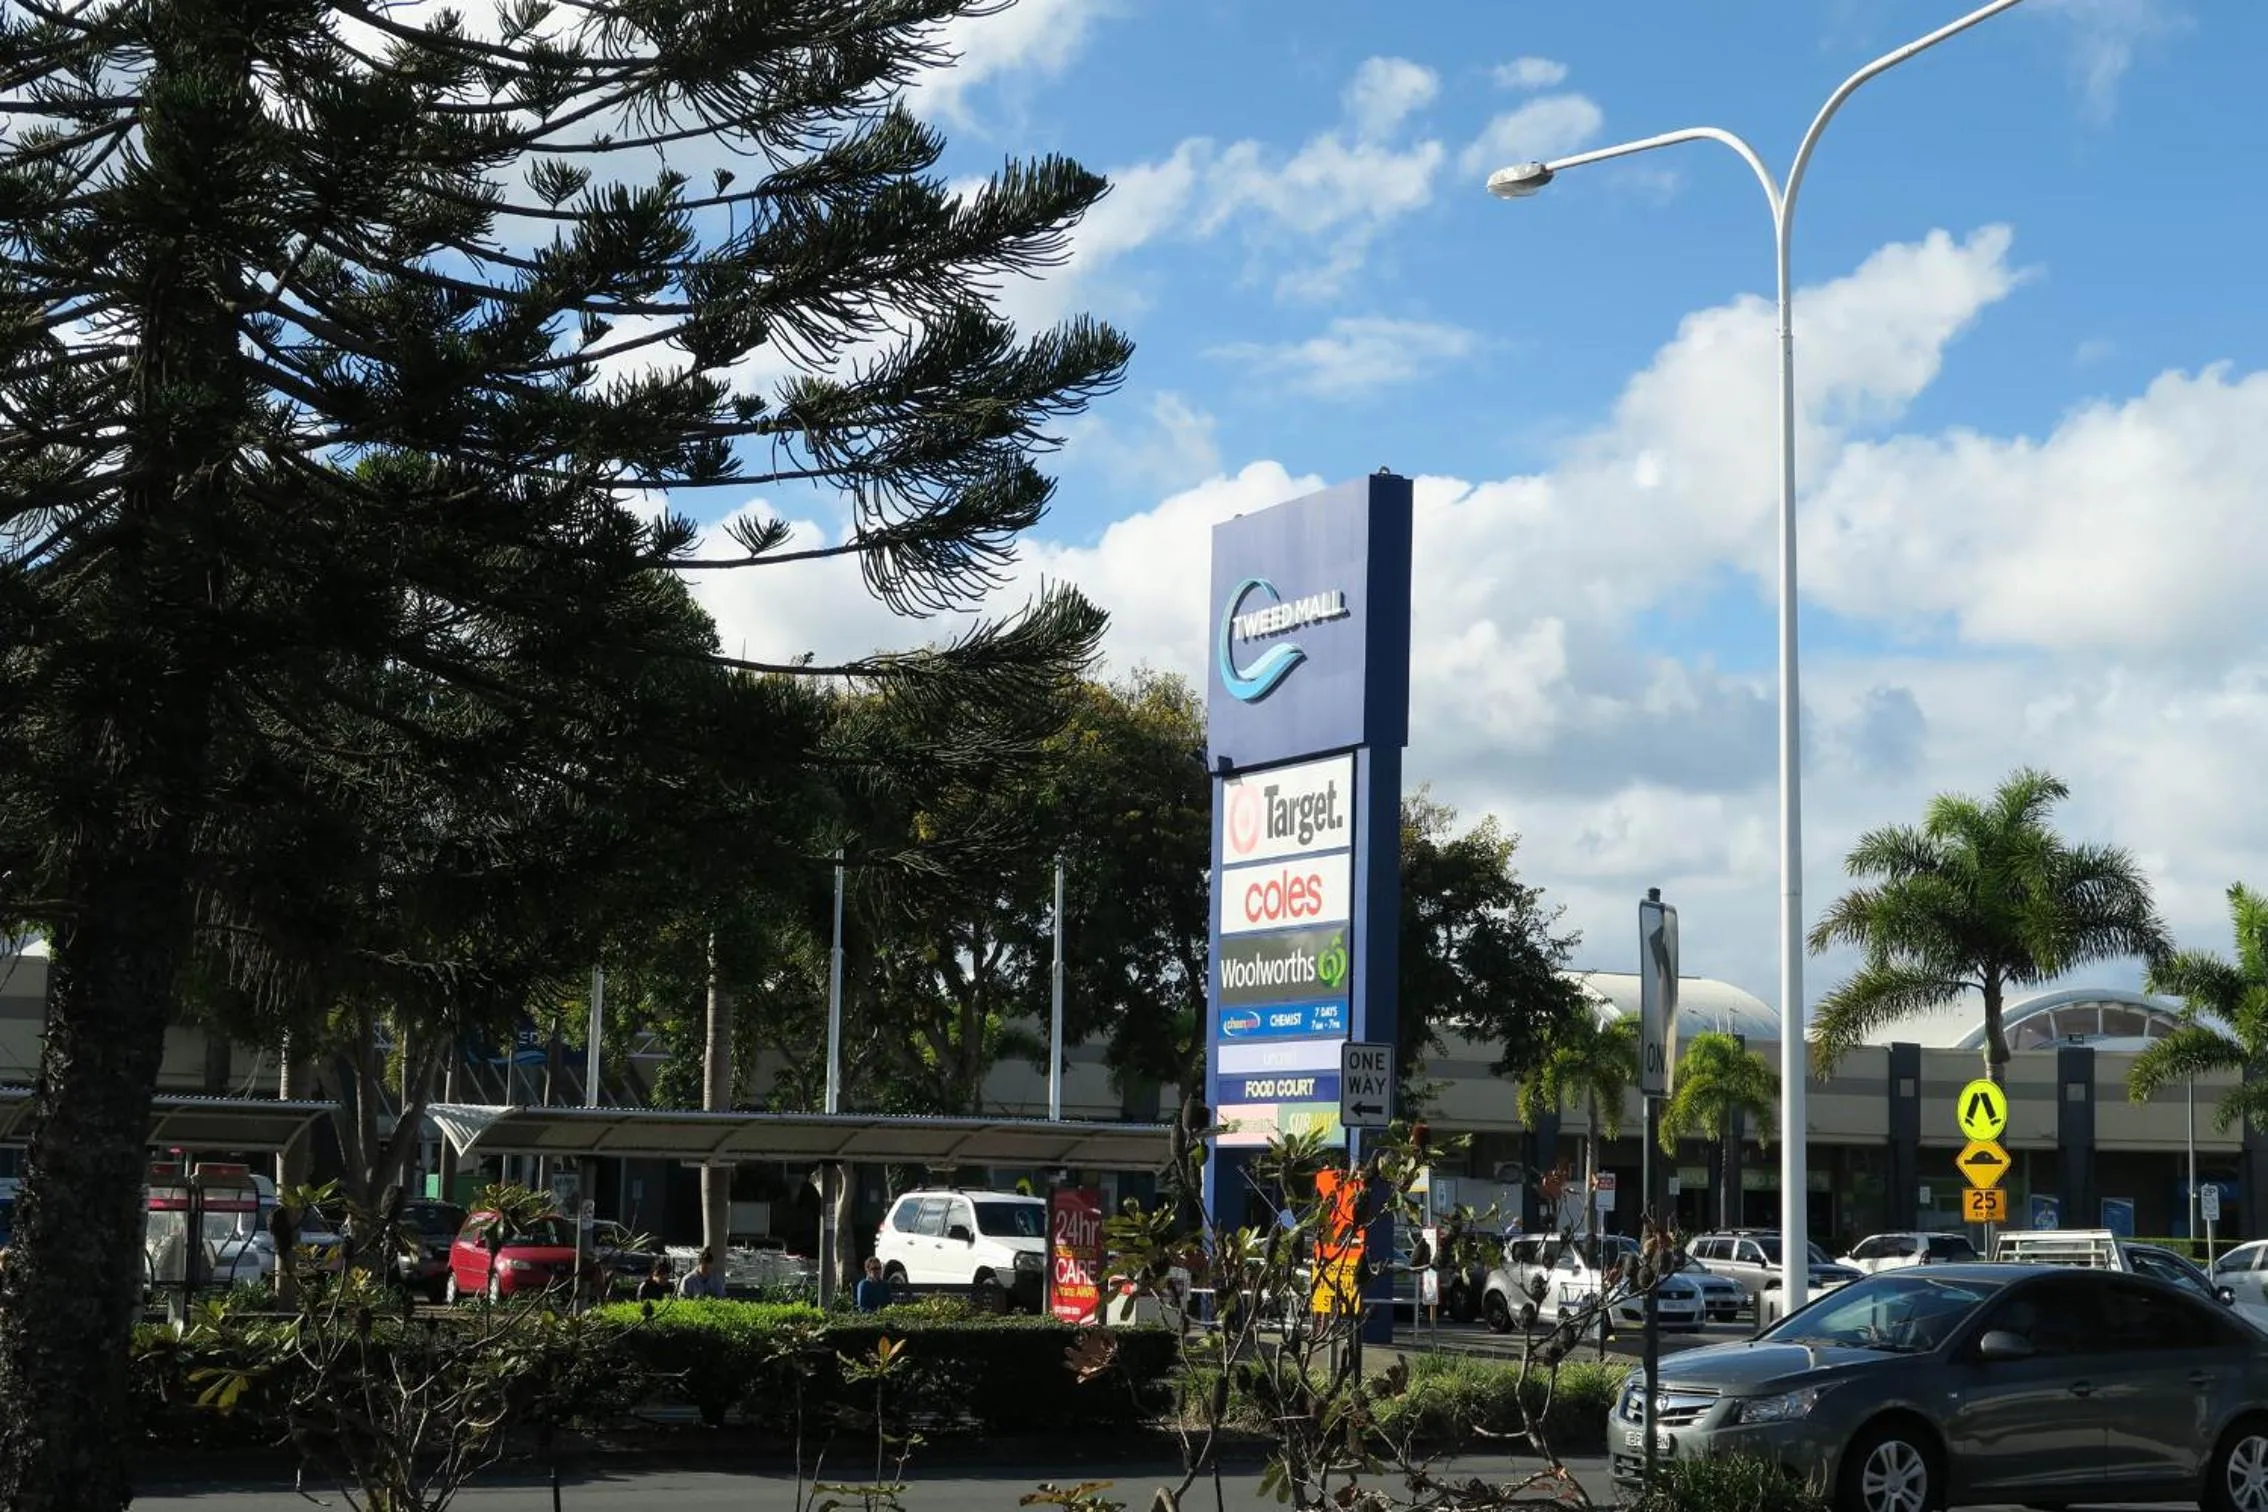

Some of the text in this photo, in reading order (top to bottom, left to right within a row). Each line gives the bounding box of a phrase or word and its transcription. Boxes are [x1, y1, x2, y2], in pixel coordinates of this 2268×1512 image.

[1233, 589, 1346, 640] TWEED MALL
[1264, 779, 1343, 846] Target.
[1245, 869, 1322, 923] coles
[1221, 948, 1316, 989] Woolworths
[1269, 1012, 1302, 1028] CHEMIST
[1320, 1005, 1338, 1017] DAYS
[1349, 1051, 1385, 1071] ONE
[1245, 1077, 1316, 1098] FOOD COURT
[1349, 1074, 1387, 1096] WAY
[1972, 1191, 1997, 1210] 25
[1056, 1210, 1099, 1246] 24hr
[1055, 1257, 1098, 1286] CARE
